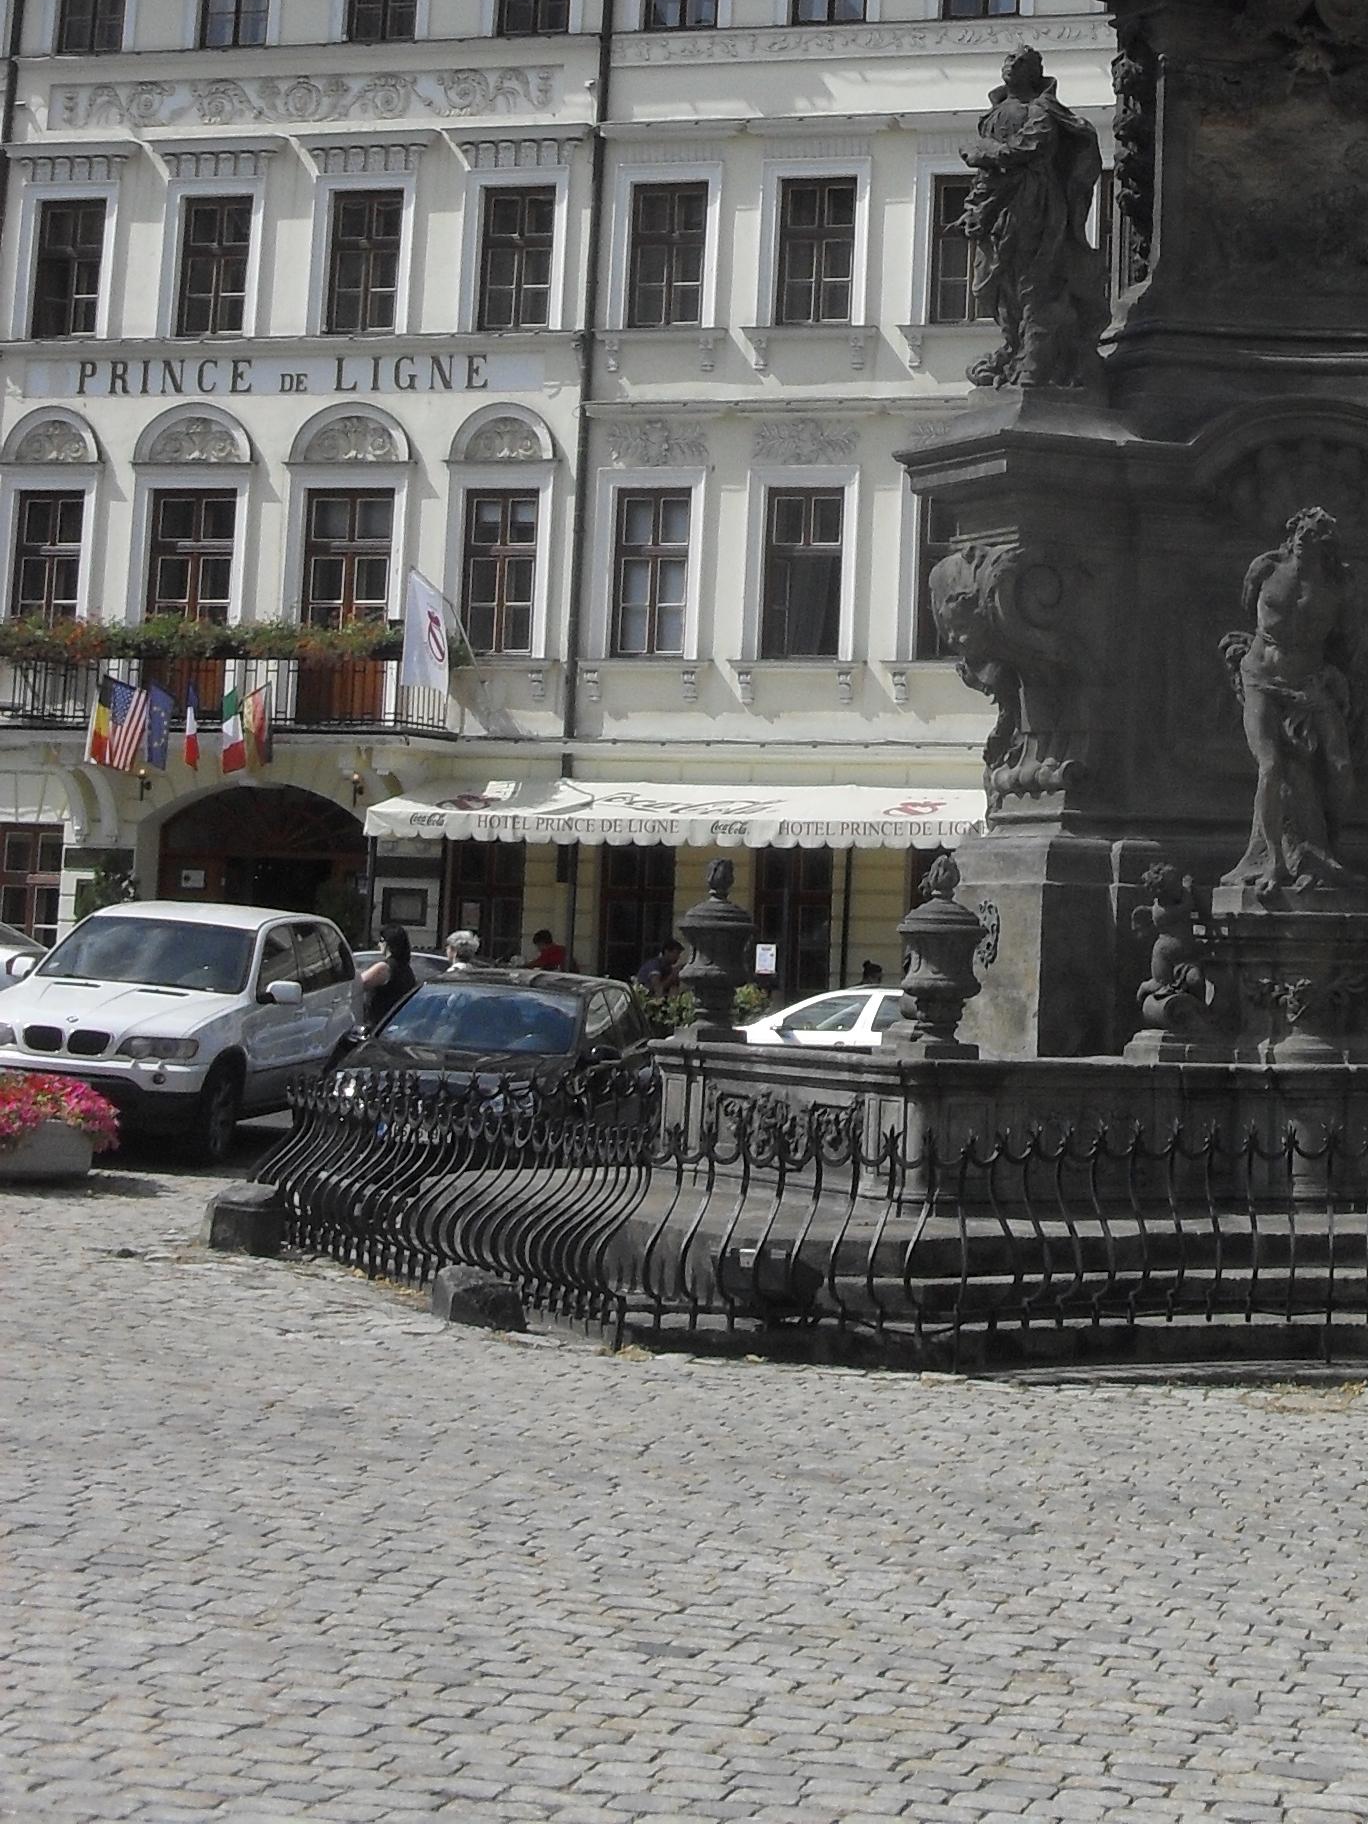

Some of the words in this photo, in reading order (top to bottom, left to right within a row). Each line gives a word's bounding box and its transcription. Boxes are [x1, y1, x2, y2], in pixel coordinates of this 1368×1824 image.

[76, 359, 252, 394] PRINCE
[279, 372, 308, 393] DE
[334, 353, 489, 392] LIGNE
[477, 814, 530, 831] HOTEL
[535, 816, 595, 833] PRINCE
[600, 818, 623, 833] DE
[628, 818, 680, 834] LIGNE
[778, 819, 835, 837] HOTEL
[840, 819, 904, 837] PRINCE
[908, 819, 933, 837] DE
